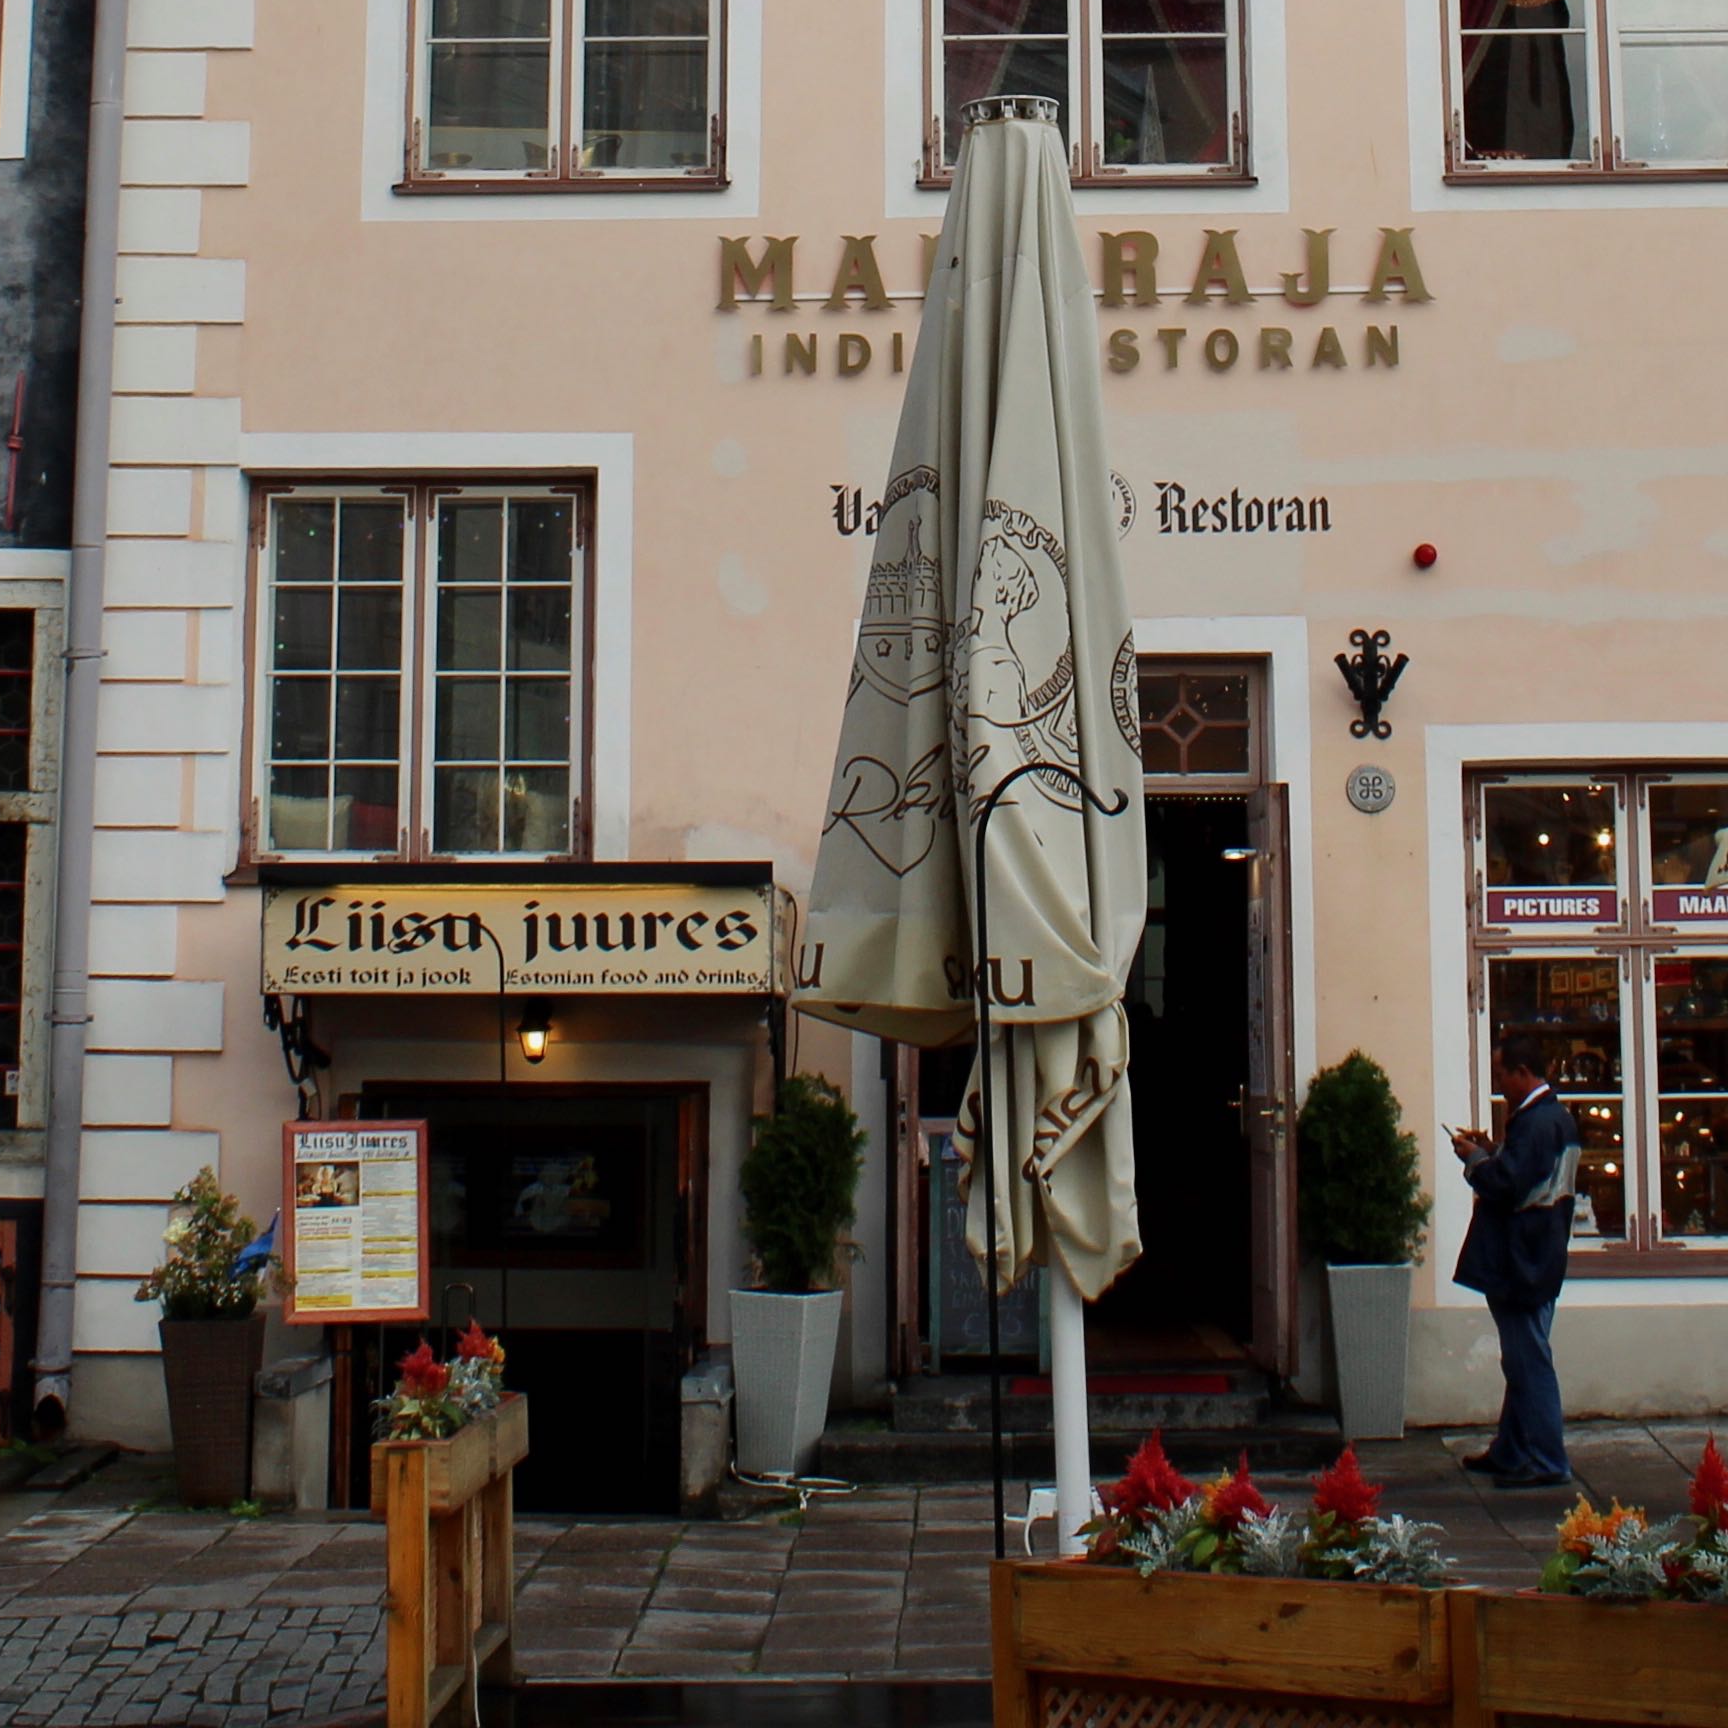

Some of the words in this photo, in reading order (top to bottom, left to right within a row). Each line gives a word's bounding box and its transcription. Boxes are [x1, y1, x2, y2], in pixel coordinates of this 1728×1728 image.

[715, 227, 1435, 313] MARAJA
[751, 331, 903, 375] INDI
[1107, 324, 1400, 374] STORAN
[1156, 482, 1332, 536] Restoran
[285, 895, 485, 953] Liisu
[522, 899, 759, 965] juures
[1503, 897, 1601, 917] PICTURES
[283, 965, 342, 985] Eesti
[350, 966, 390, 985] toit
[396, 967, 415, 988] ja
[421, 966, 473, 988] jook
[503, 968, 594, 986] Estonian
[601, 968, 649, 985] food
[654, 968, 690, 985] and
[695, 968, 758, 985] drinks
